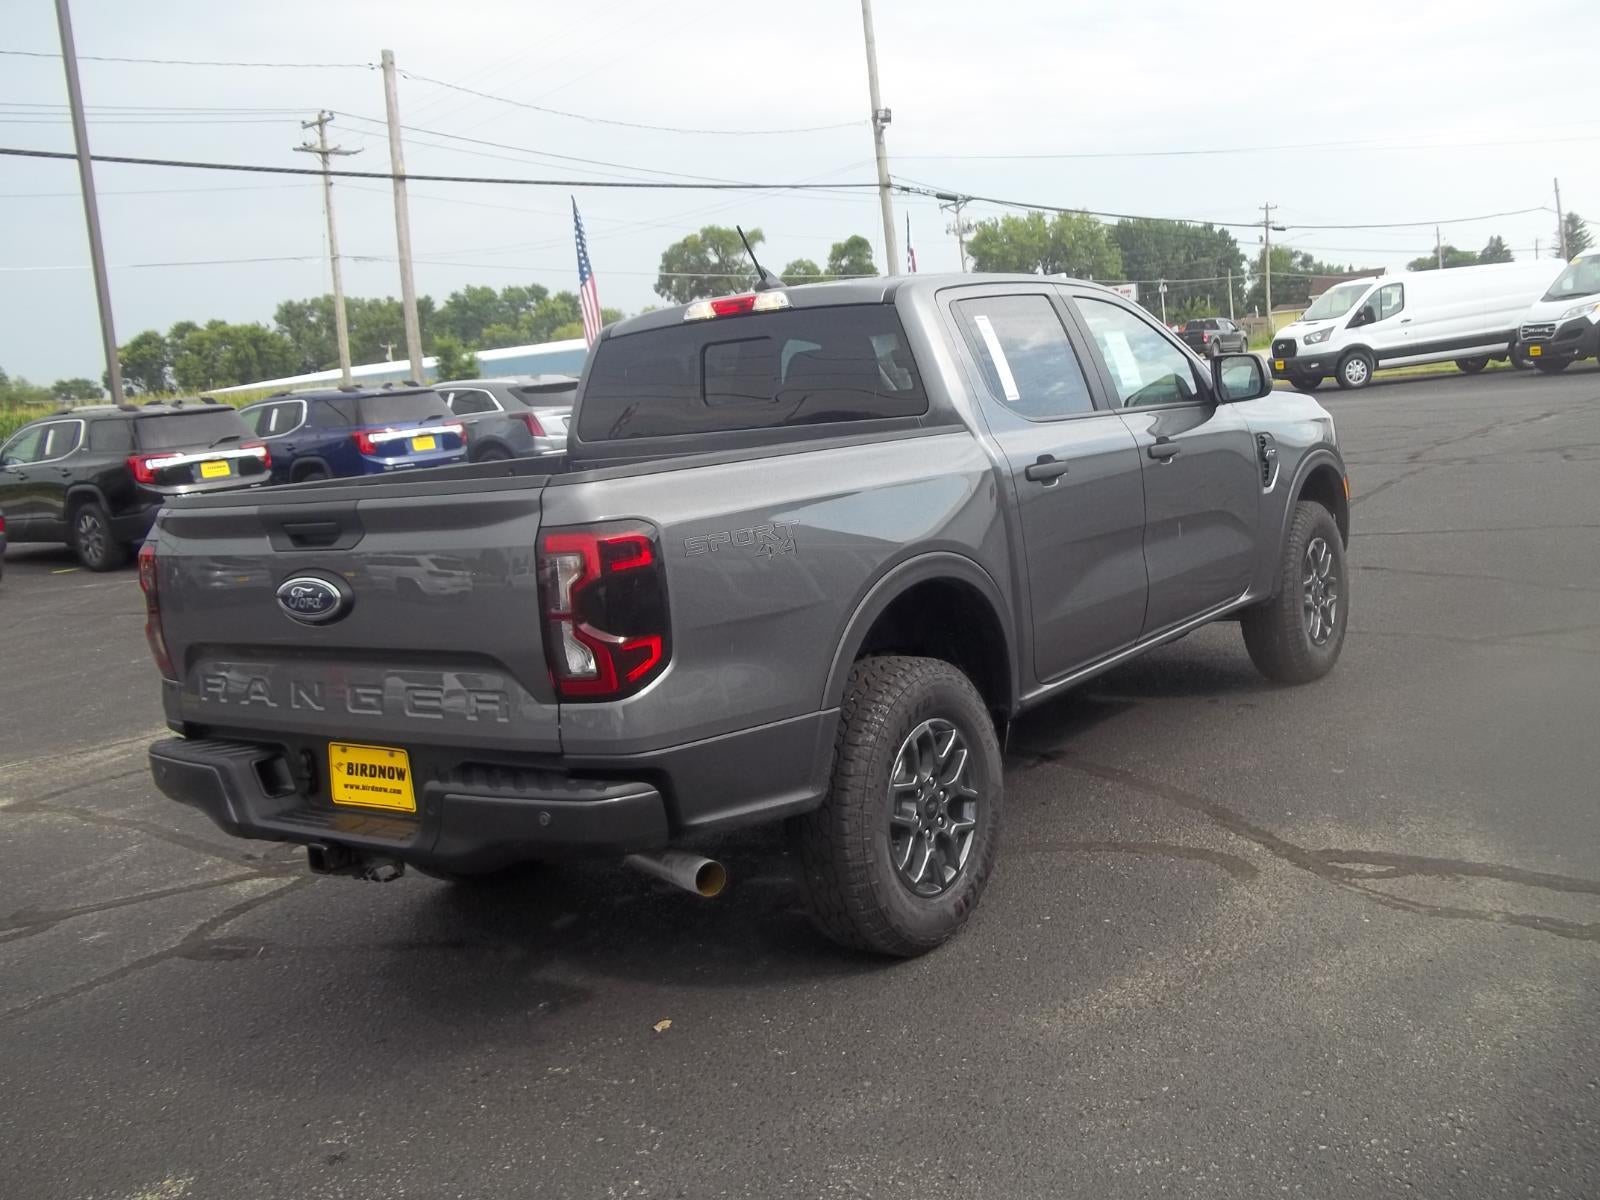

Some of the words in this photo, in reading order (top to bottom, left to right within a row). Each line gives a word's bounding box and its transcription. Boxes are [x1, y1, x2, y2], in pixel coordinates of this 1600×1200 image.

[684, 520, 800, 557] SPORT
[288, 586, 323, 609] Ford
[201, 673, 509, 723] RANGER
[346, 761, 406, 781] BIRDNOW
[343, 783, 402, 795] www.birdnow.com
